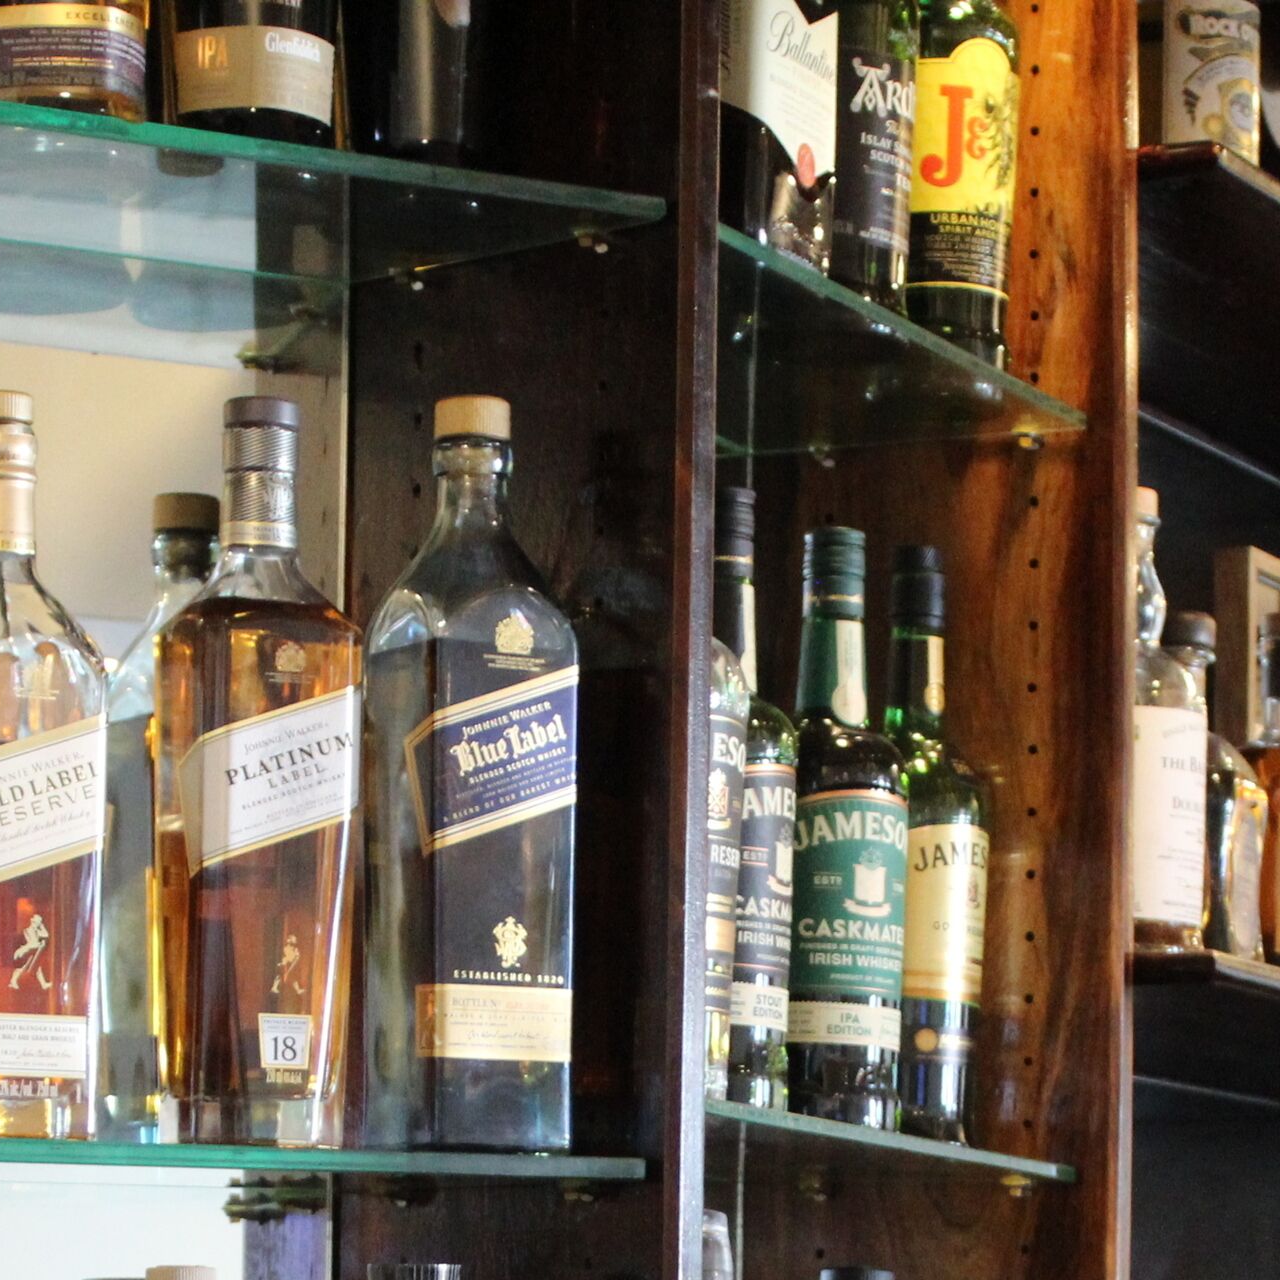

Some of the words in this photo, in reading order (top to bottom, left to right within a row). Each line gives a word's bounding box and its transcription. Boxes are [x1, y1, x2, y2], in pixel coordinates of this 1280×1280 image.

[198, 35, 228, 68] IPA
[265, 32, 320, 63] Glenfiddich
[930, 213, 978, 226] URBAN
[462, 716, 509, 739] JOHNNIE
[509, 701, 551, 721] WALKER
[244, 736, 281, 755] JOHNNIE
[285, 722, 324, 740] WALKER
[450, 738, 509, 776] Blue
[503, 714, 567, 759] Label
[31, 751, 80, 773] WALKER
[225, 733, 353, 786] PLATINUM
[470, 767, 504, 784] BLENDED
[506, 757, 535, 772] SCOTCH
[538, 746, 566, 761] WHISKY
[1161, 756, 1185, 770] THE
[30, 762, 99, 795] LABEL
[268, 764, 328, 789] LABEL
[453, 804, 480, 820] BLEND
[500, 794, 516, 804] OUR
[520, 782, 551, 797] RAREST
[738, 930, 774, 945] IRISH
[798, 918, 903, 945] CASKMATE
[810, 952, 853, 966] IRISH
[454, 970, 531, 982] ESTABLISHED
[537, 975, 564, 984] 1820
[756, 992, 782, 1008] STOUT
[752, 1006, 783, 1020] EDITION
[840, 1012, 859, 1025] IPA
[827, 1022, 871, 1036] EDITION
[272, 1036, 296, 1061] 18
